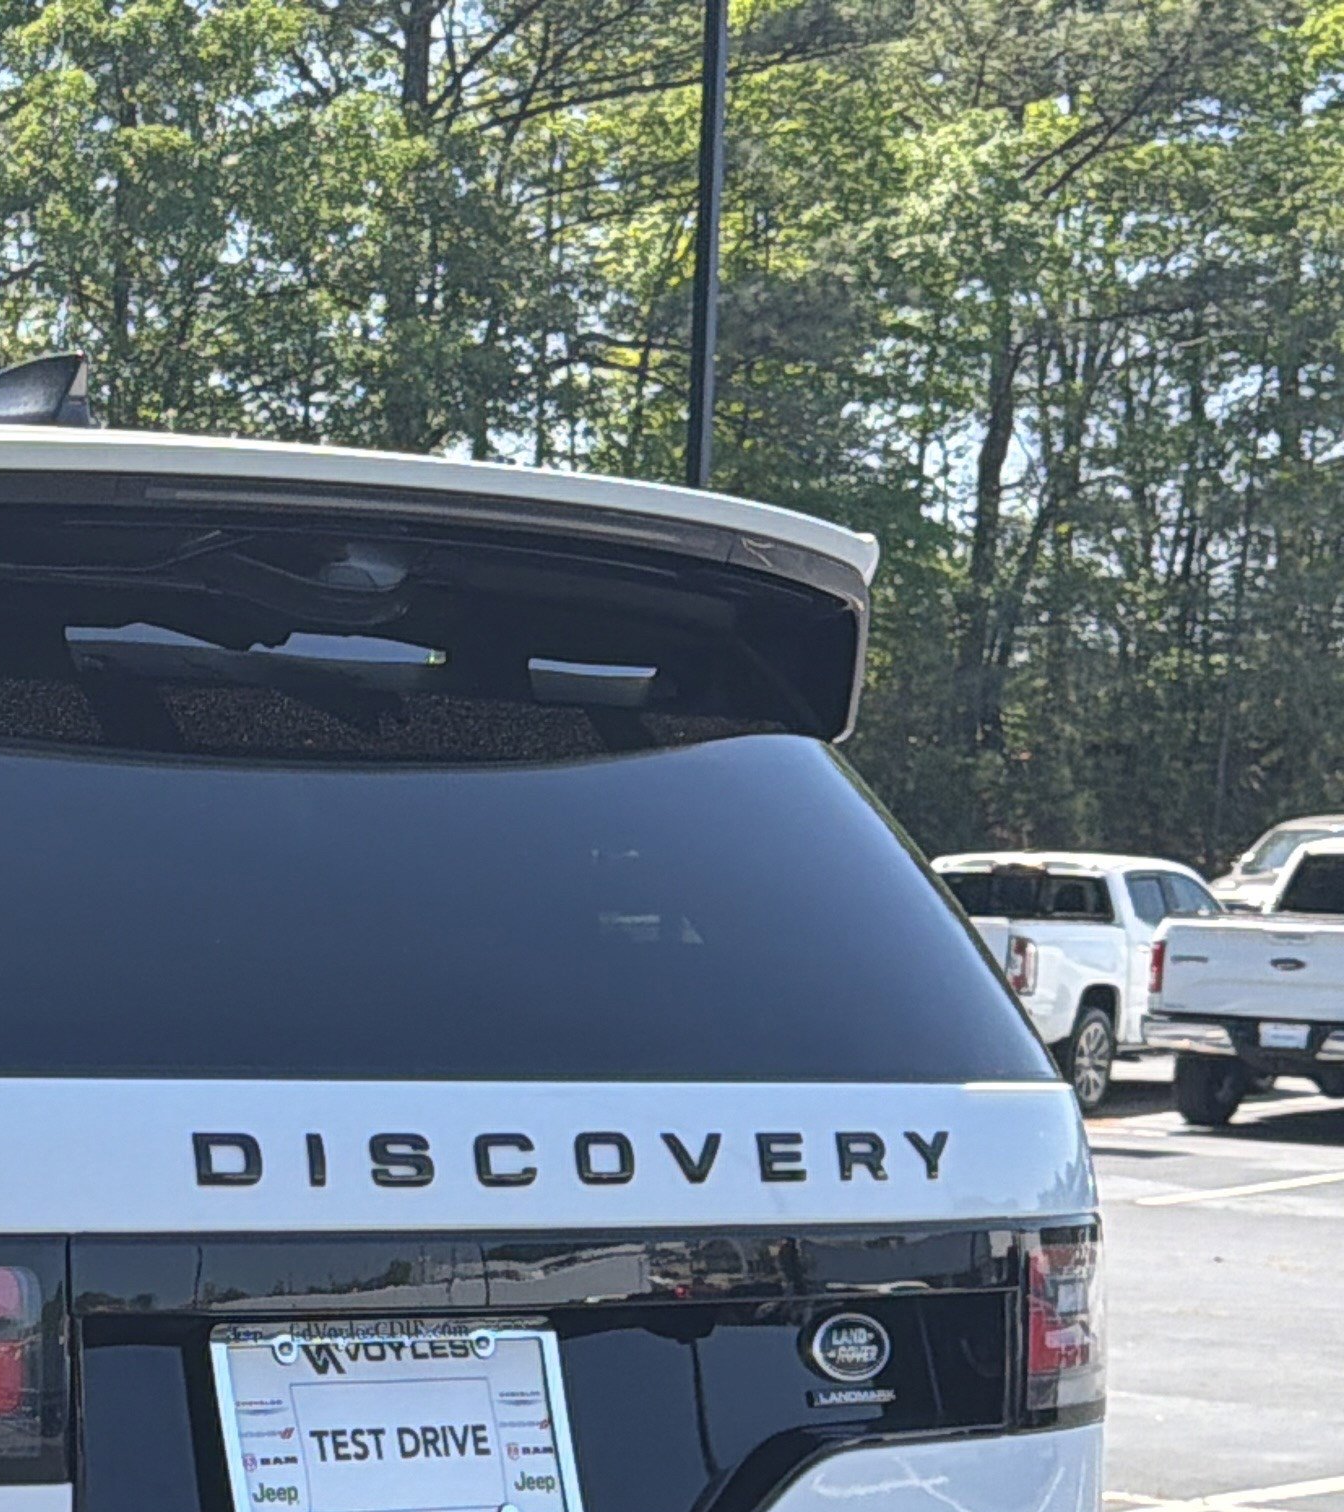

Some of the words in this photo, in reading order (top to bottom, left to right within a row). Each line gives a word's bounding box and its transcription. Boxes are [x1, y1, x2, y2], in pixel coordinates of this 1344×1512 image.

[190, 1130, 950, 1188] DISCOVERY
[309, 1428, 386, 1461] TEST
[396, 1424, 492, 1459] DRIVE
[252, 1482, 298, 1506] Jeep
[514, 1471, 555, 1493] Jeep
